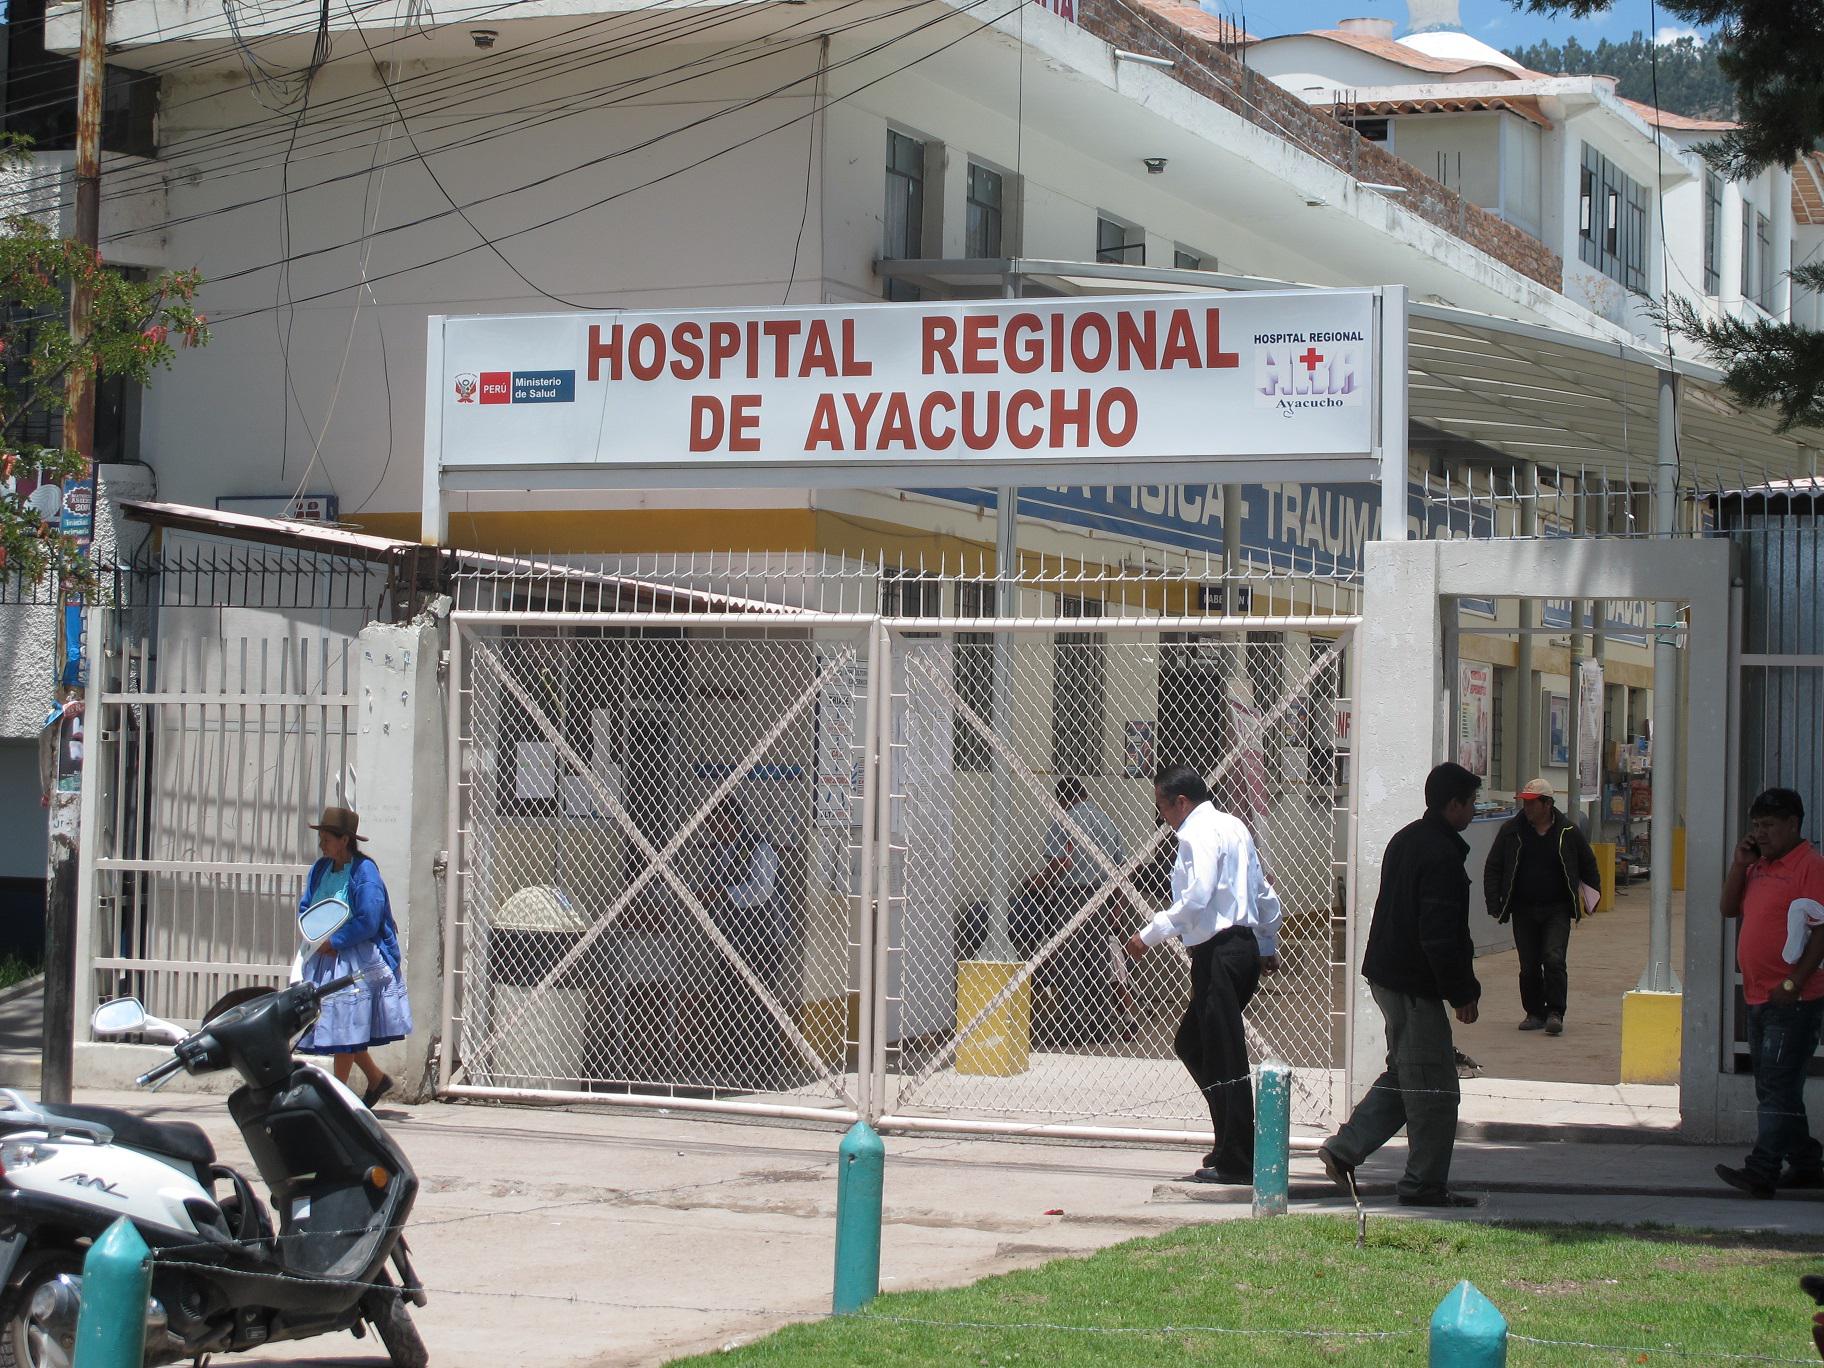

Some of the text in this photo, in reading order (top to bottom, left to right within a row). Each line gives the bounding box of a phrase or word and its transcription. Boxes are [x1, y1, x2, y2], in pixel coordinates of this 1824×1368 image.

[1254, 331, 1364, 344] HOSPITAL REGIONAL
[587, 307, 1240, 382] HOSPITAL REGIONAL
[483, 382, 507, 395] PERÚ
[515, 377, 562, 388] Ministerio
[515, 389, 556, 399] de Salud
[1275, 397, 1344, 418] Ayacucho
[689, 386, 1139, 452] DE AYACUCHO
